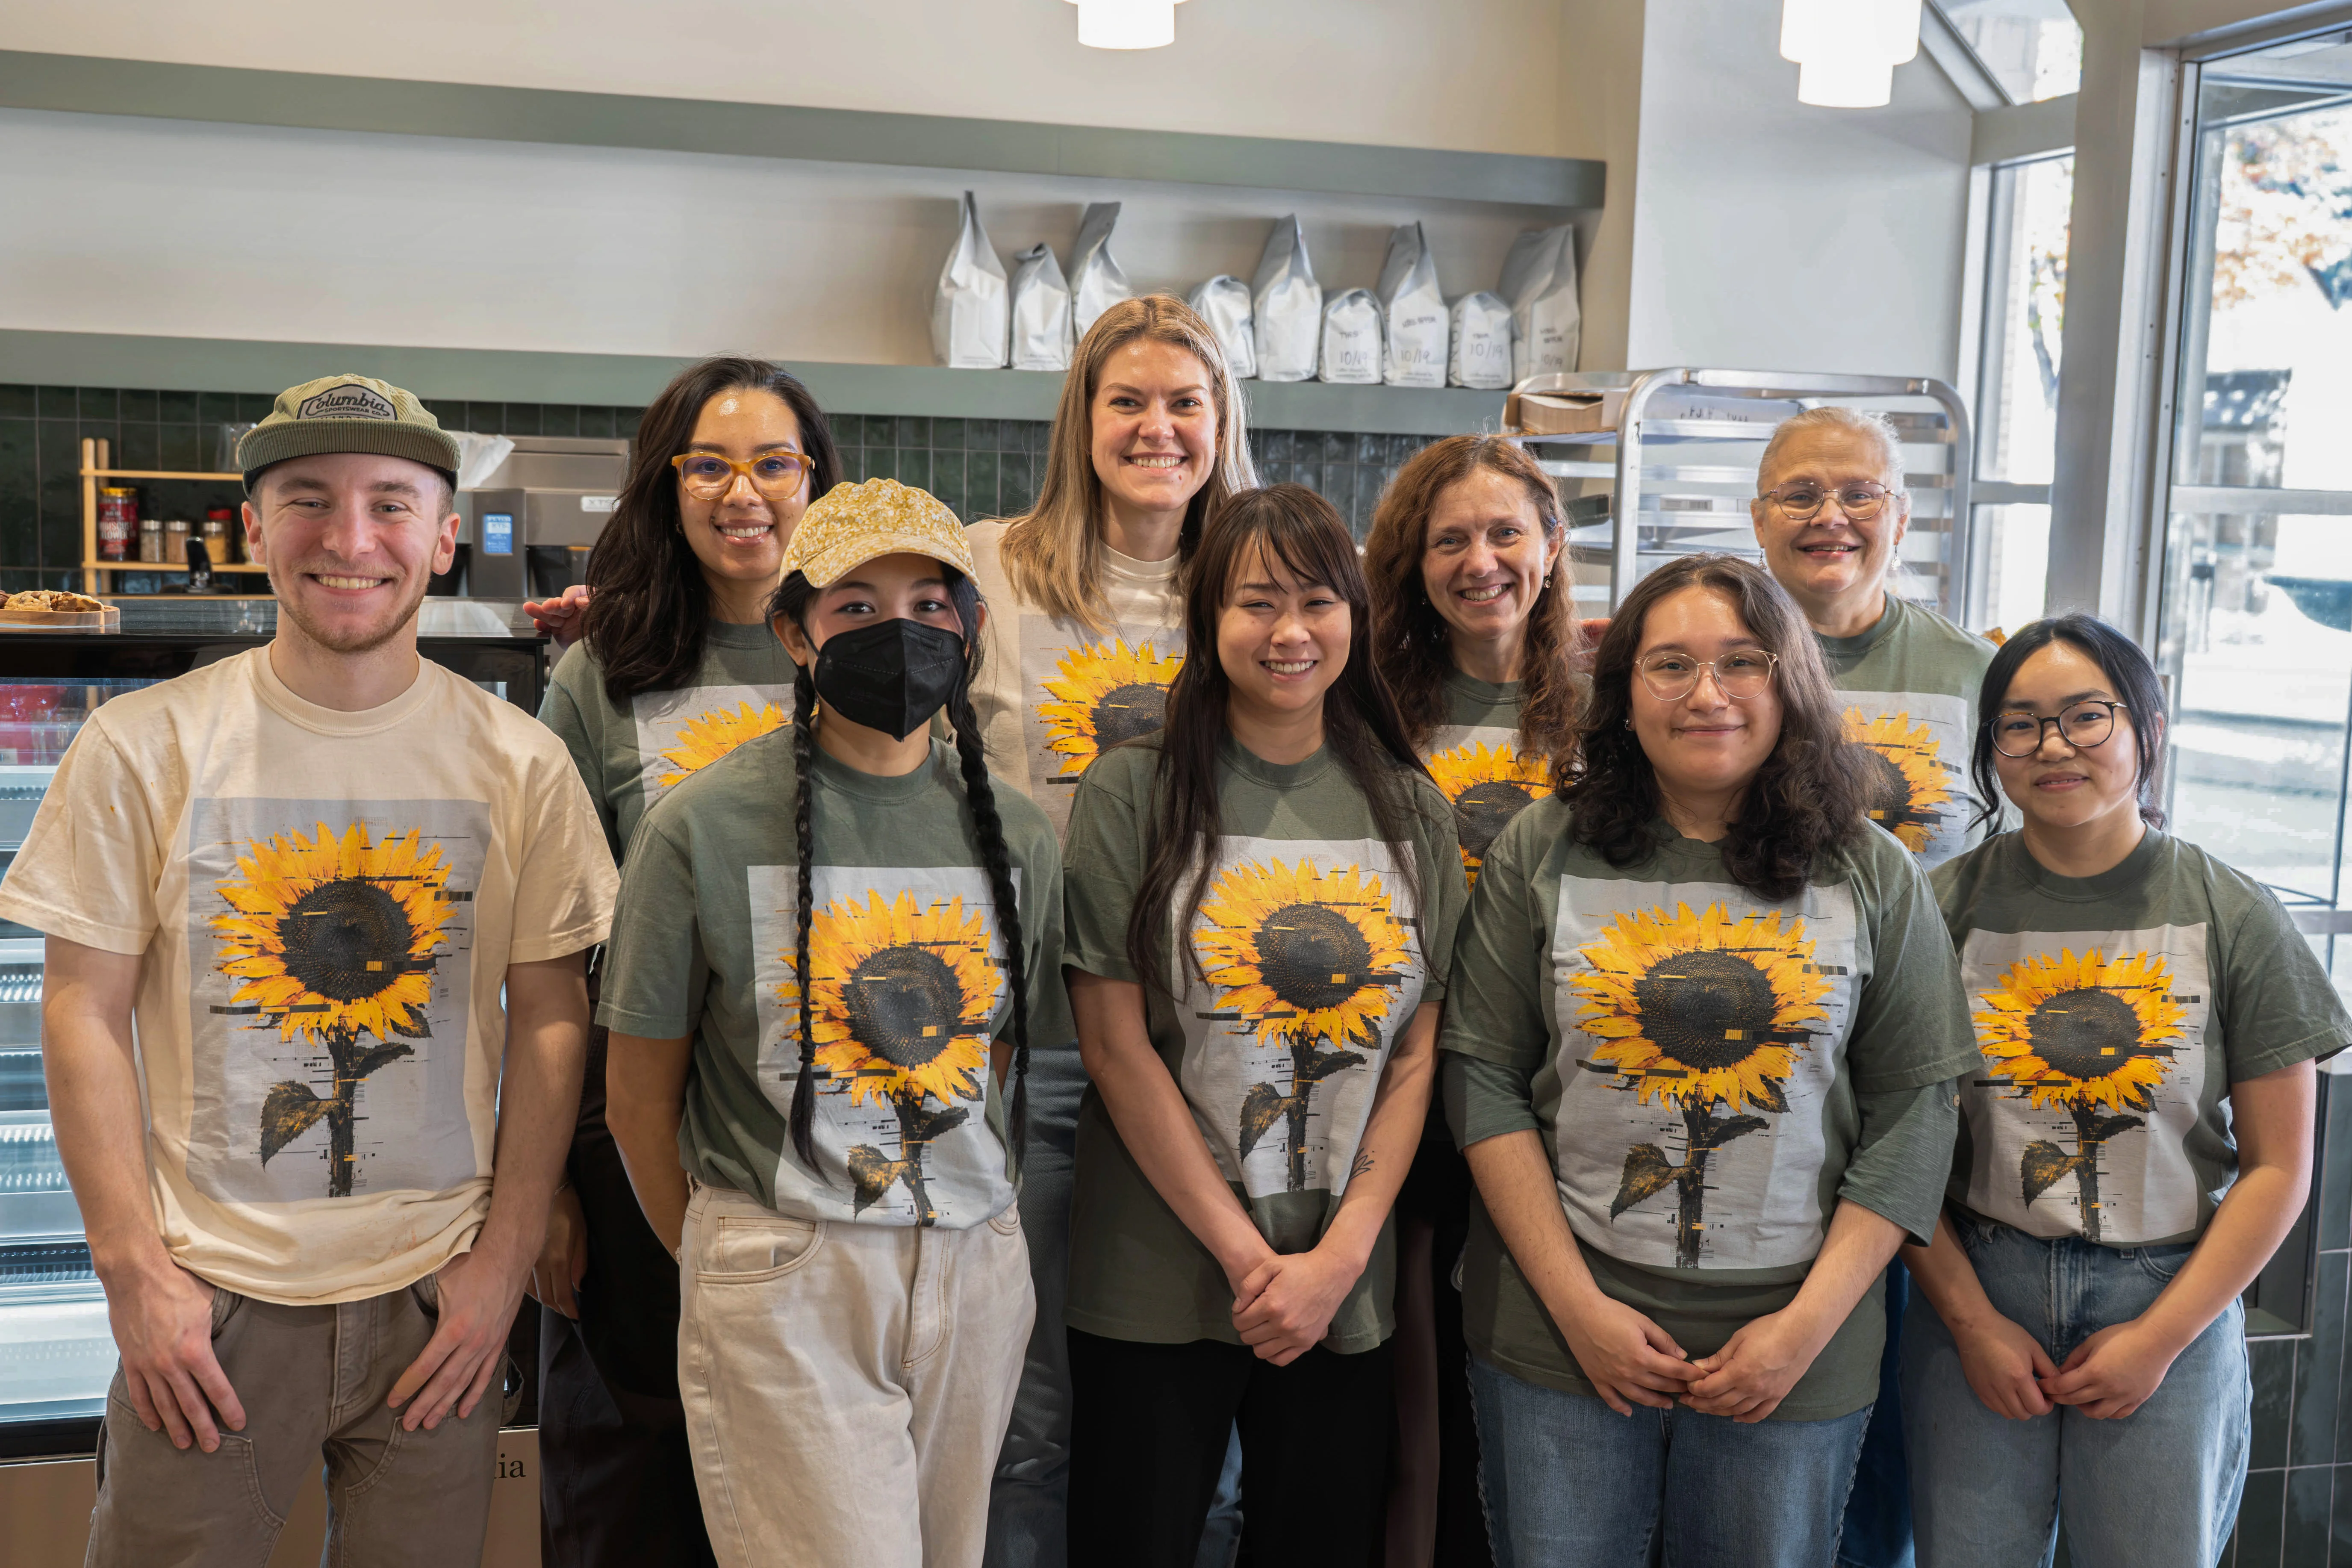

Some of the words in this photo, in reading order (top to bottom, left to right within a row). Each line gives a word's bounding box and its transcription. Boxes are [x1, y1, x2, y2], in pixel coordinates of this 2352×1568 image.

[1471, 341, 1503, 358] 10/19
[305, 392, 390, 416] Columbia
[494, 1453, 526, 1479] ia
